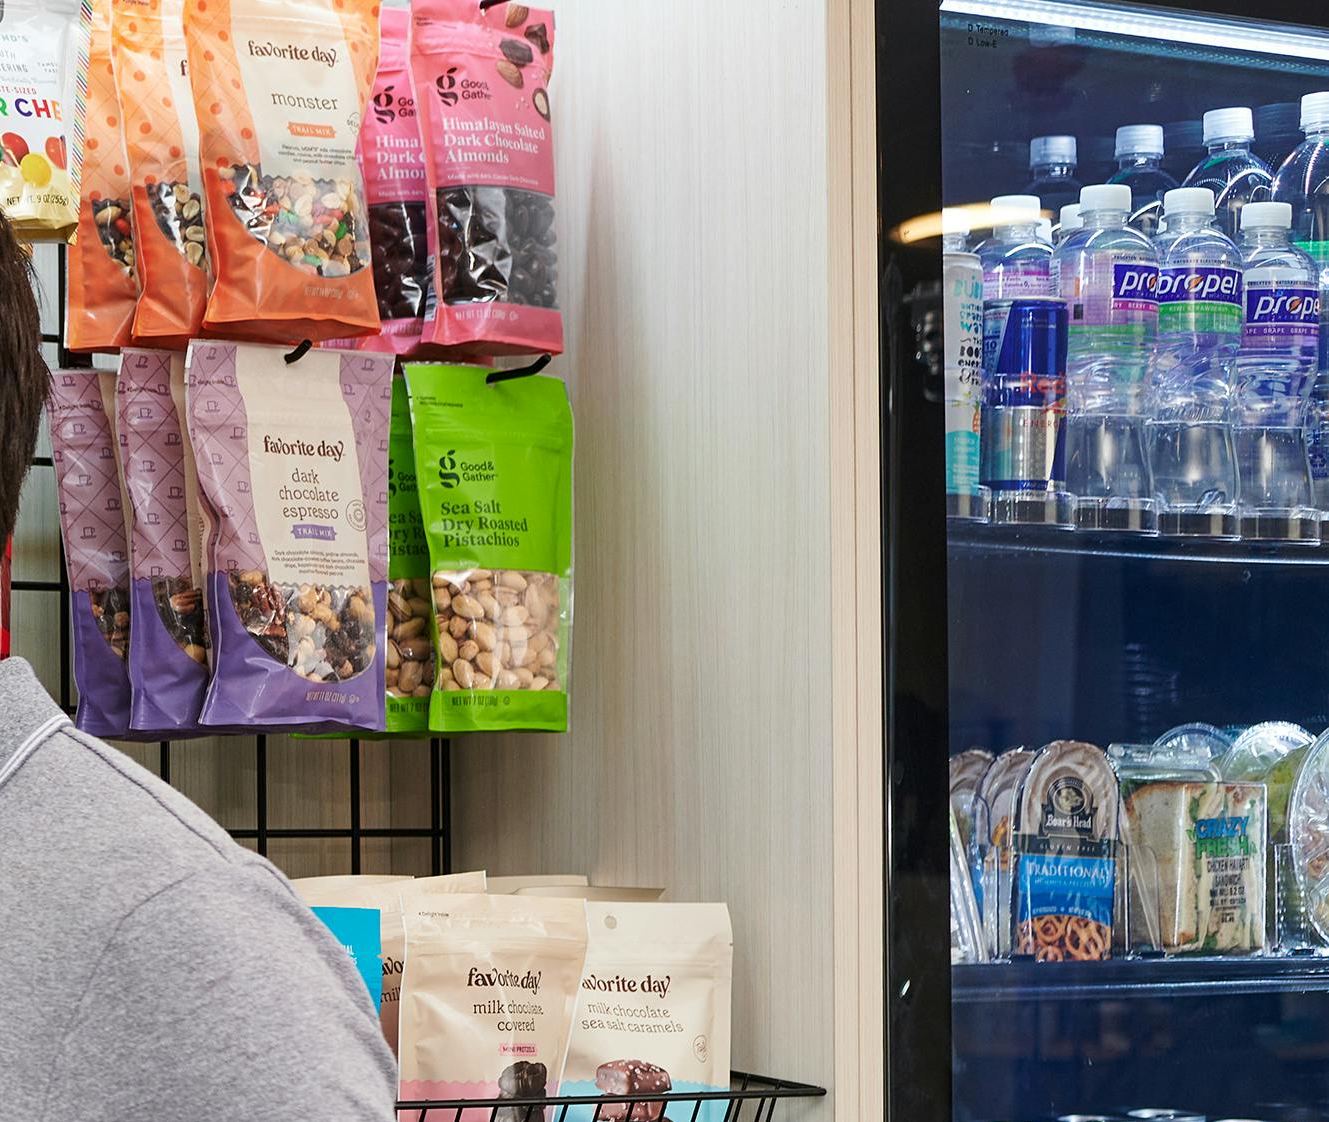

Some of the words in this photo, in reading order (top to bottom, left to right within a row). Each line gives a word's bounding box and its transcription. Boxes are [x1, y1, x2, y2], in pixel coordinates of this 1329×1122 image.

[248, 40, 310, 61] favorite
[271, 91, 339, 111] monster
[292, 125, 315, 136] TRAIL
[315, 126, 332, 137] MIX
[442, 117, 513, 135] Himalayan
[513, 122, 545, 140] Salted
[443, 133, 482, 147] Dark
[484, 134, 539, 154] Chocolate
[377, 150, 416, 165] Dark
[445, 149, 510, 164] Almonds
[1157, 271, 1239, 299] propel
[1263, 327, 1285, 335] GRAPE
[263, 435, 315, 458] favorite
[316, 438, 345, 462] day
[460, 461, 494, 472] Good&
[291, 467, 320, 486] dark
[462, 472, 496, 482] Gather
[278, 484, 340, 503] chocolate
[282, 504, 340, 521] espresso
[441, 501, 470, 515] Sea
[473, 500, 501, 514] Salt
[296, 527, 318, 537] TRAIL
[319, 527, 333, 538] MIX
[442, 518, 474, 534] Dry
[478, 516, 528, 532] Roasted
[444, 532, 520, 548] Pistachios
[1045, 814, 1072, 827] Boar's
[1072, 816, 1092, 828] Head
[1196, 815, 1249, 838] CRAZY
[467, 967, 521, 988] favorite
[473, 1000, 505, 1015] milk
[587, 1002, 611, 1016] milk
[612, 1005, 671, 1019] chocolate
[497, 1018, 536, 1032] covered
[581, 1018, 606, 1031] sea
[606, 1017, 626, 1032] salt
[626, 1020, 685, 1034] caramels
